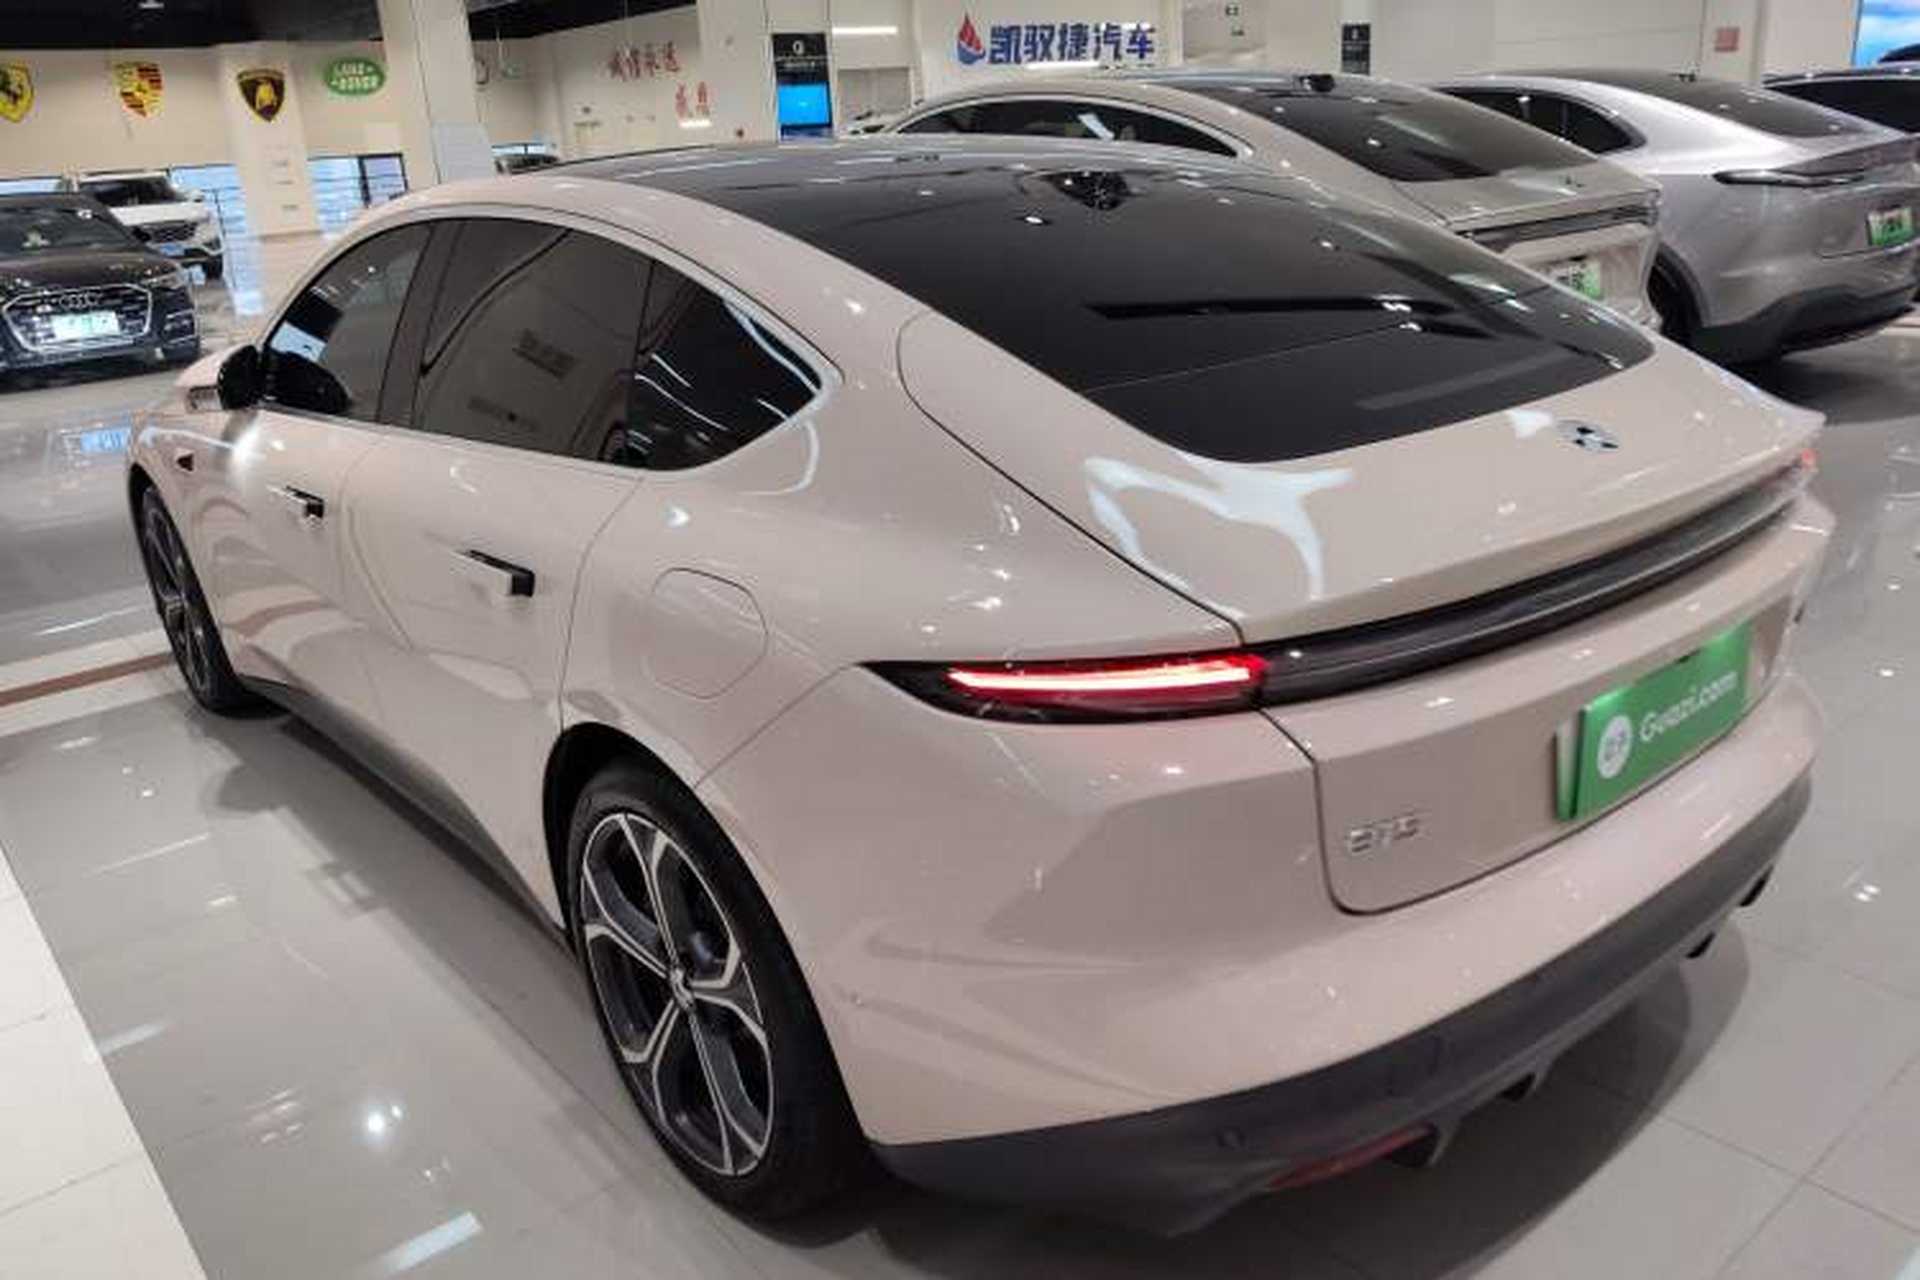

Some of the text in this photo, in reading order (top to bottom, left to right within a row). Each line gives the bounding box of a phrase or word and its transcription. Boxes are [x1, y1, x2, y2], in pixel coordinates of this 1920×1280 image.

[989, 22, 1156, 65] 凯驭捷汽车
[1639, 671, 1738, 742] Guazi.com
